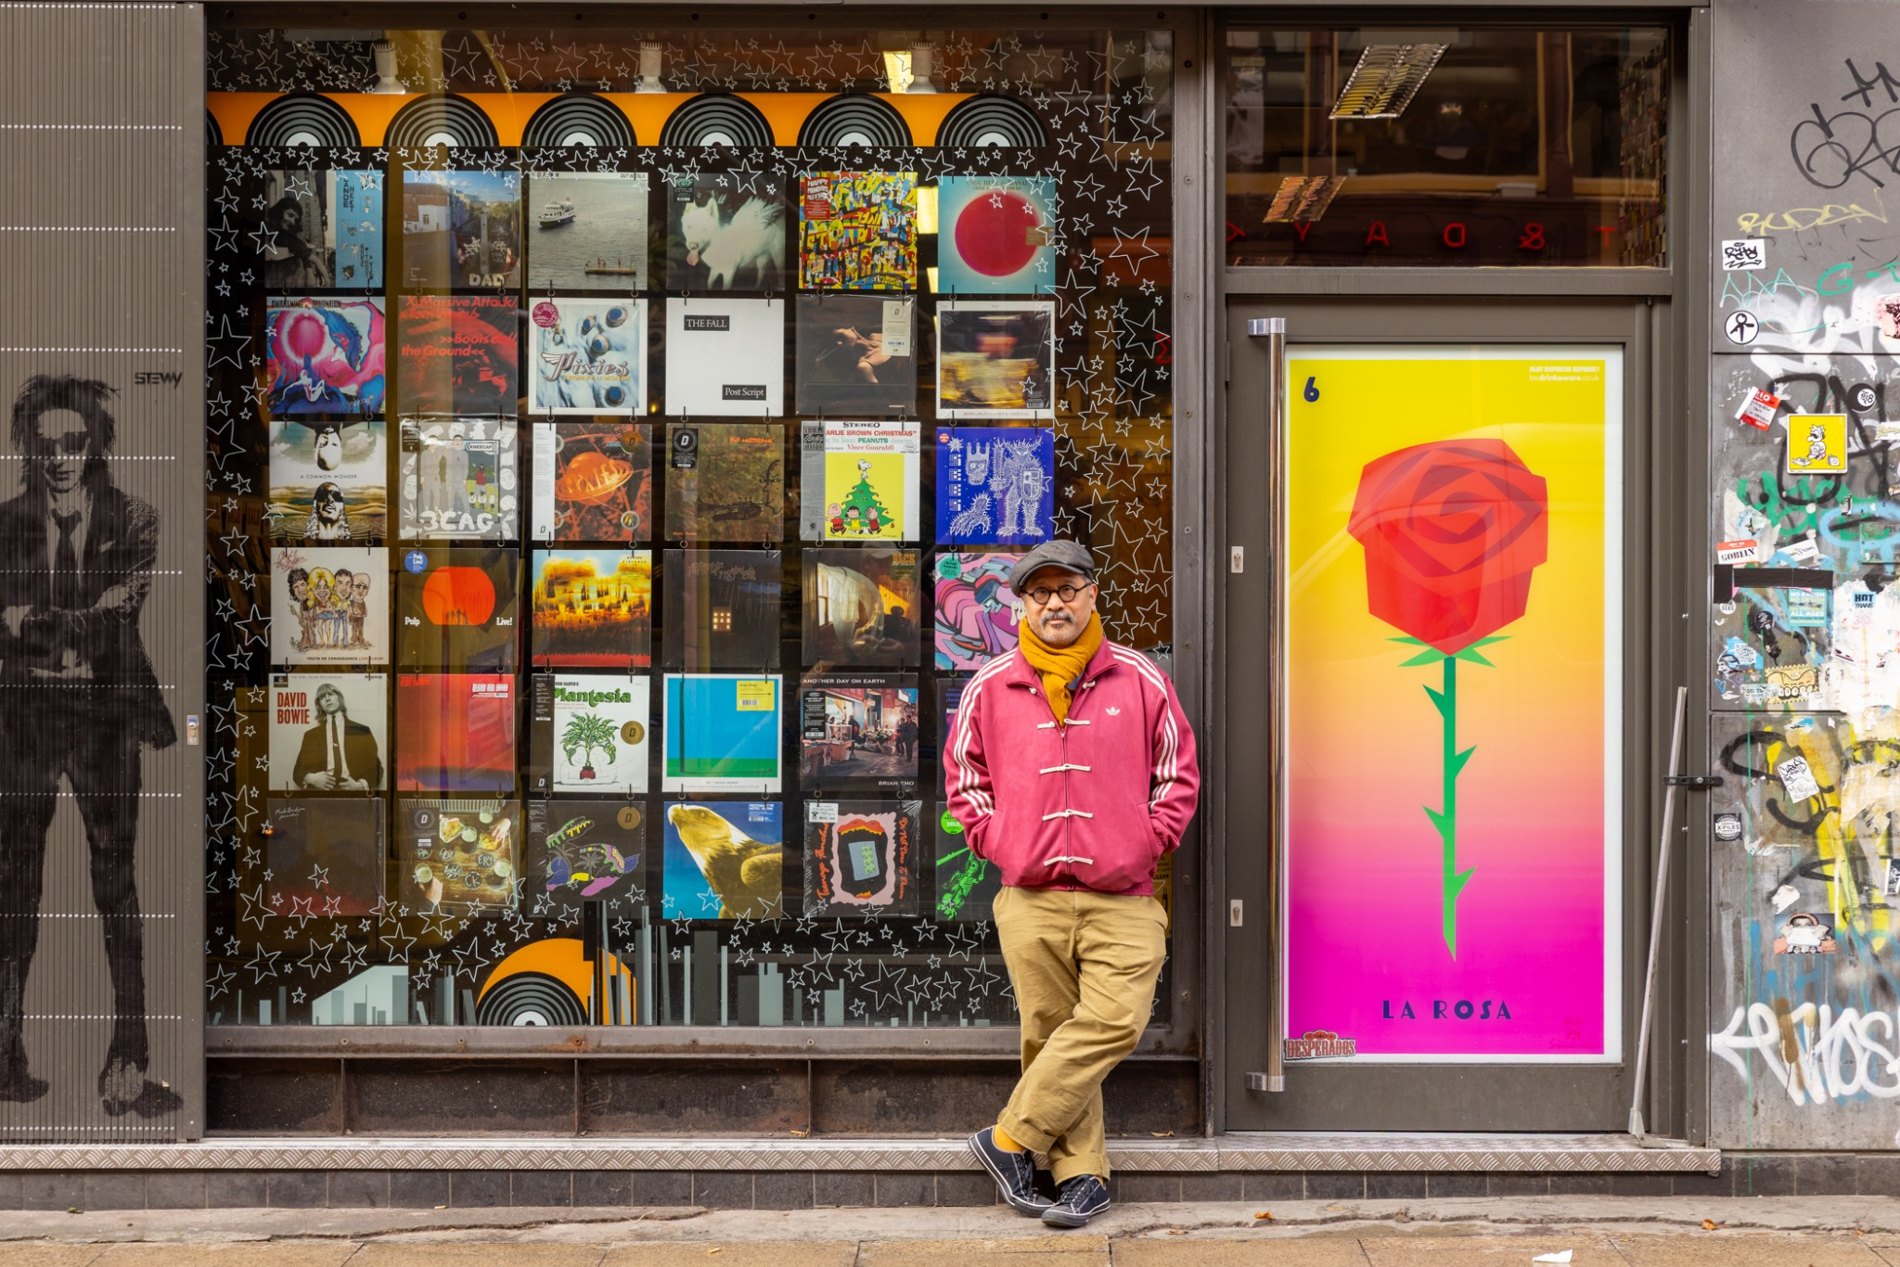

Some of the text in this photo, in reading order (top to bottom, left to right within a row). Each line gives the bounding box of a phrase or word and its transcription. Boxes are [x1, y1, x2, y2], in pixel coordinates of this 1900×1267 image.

[686, 319, 728, 329] THE FALL
[541, 352, 630, 382] Pixies
[725, 387, 764, 399] Post Script
[1304, 376, 1320, 403] 6
[680, 435, 689, 446] D
[847, 444, 865, 452] Vince
[404, 616, 421, 627] Pulp
[496, 617, 513, 626] Live!
[277, 692, 307, 708] DAVID
[554, 688, 631, 708] Plantasia
[277, 709, 310, 725] BOWIE
[1382, 1000, 1512, 1020] LA ROSA
[1286, 1038, 1356, 1059] DESPERADOS
